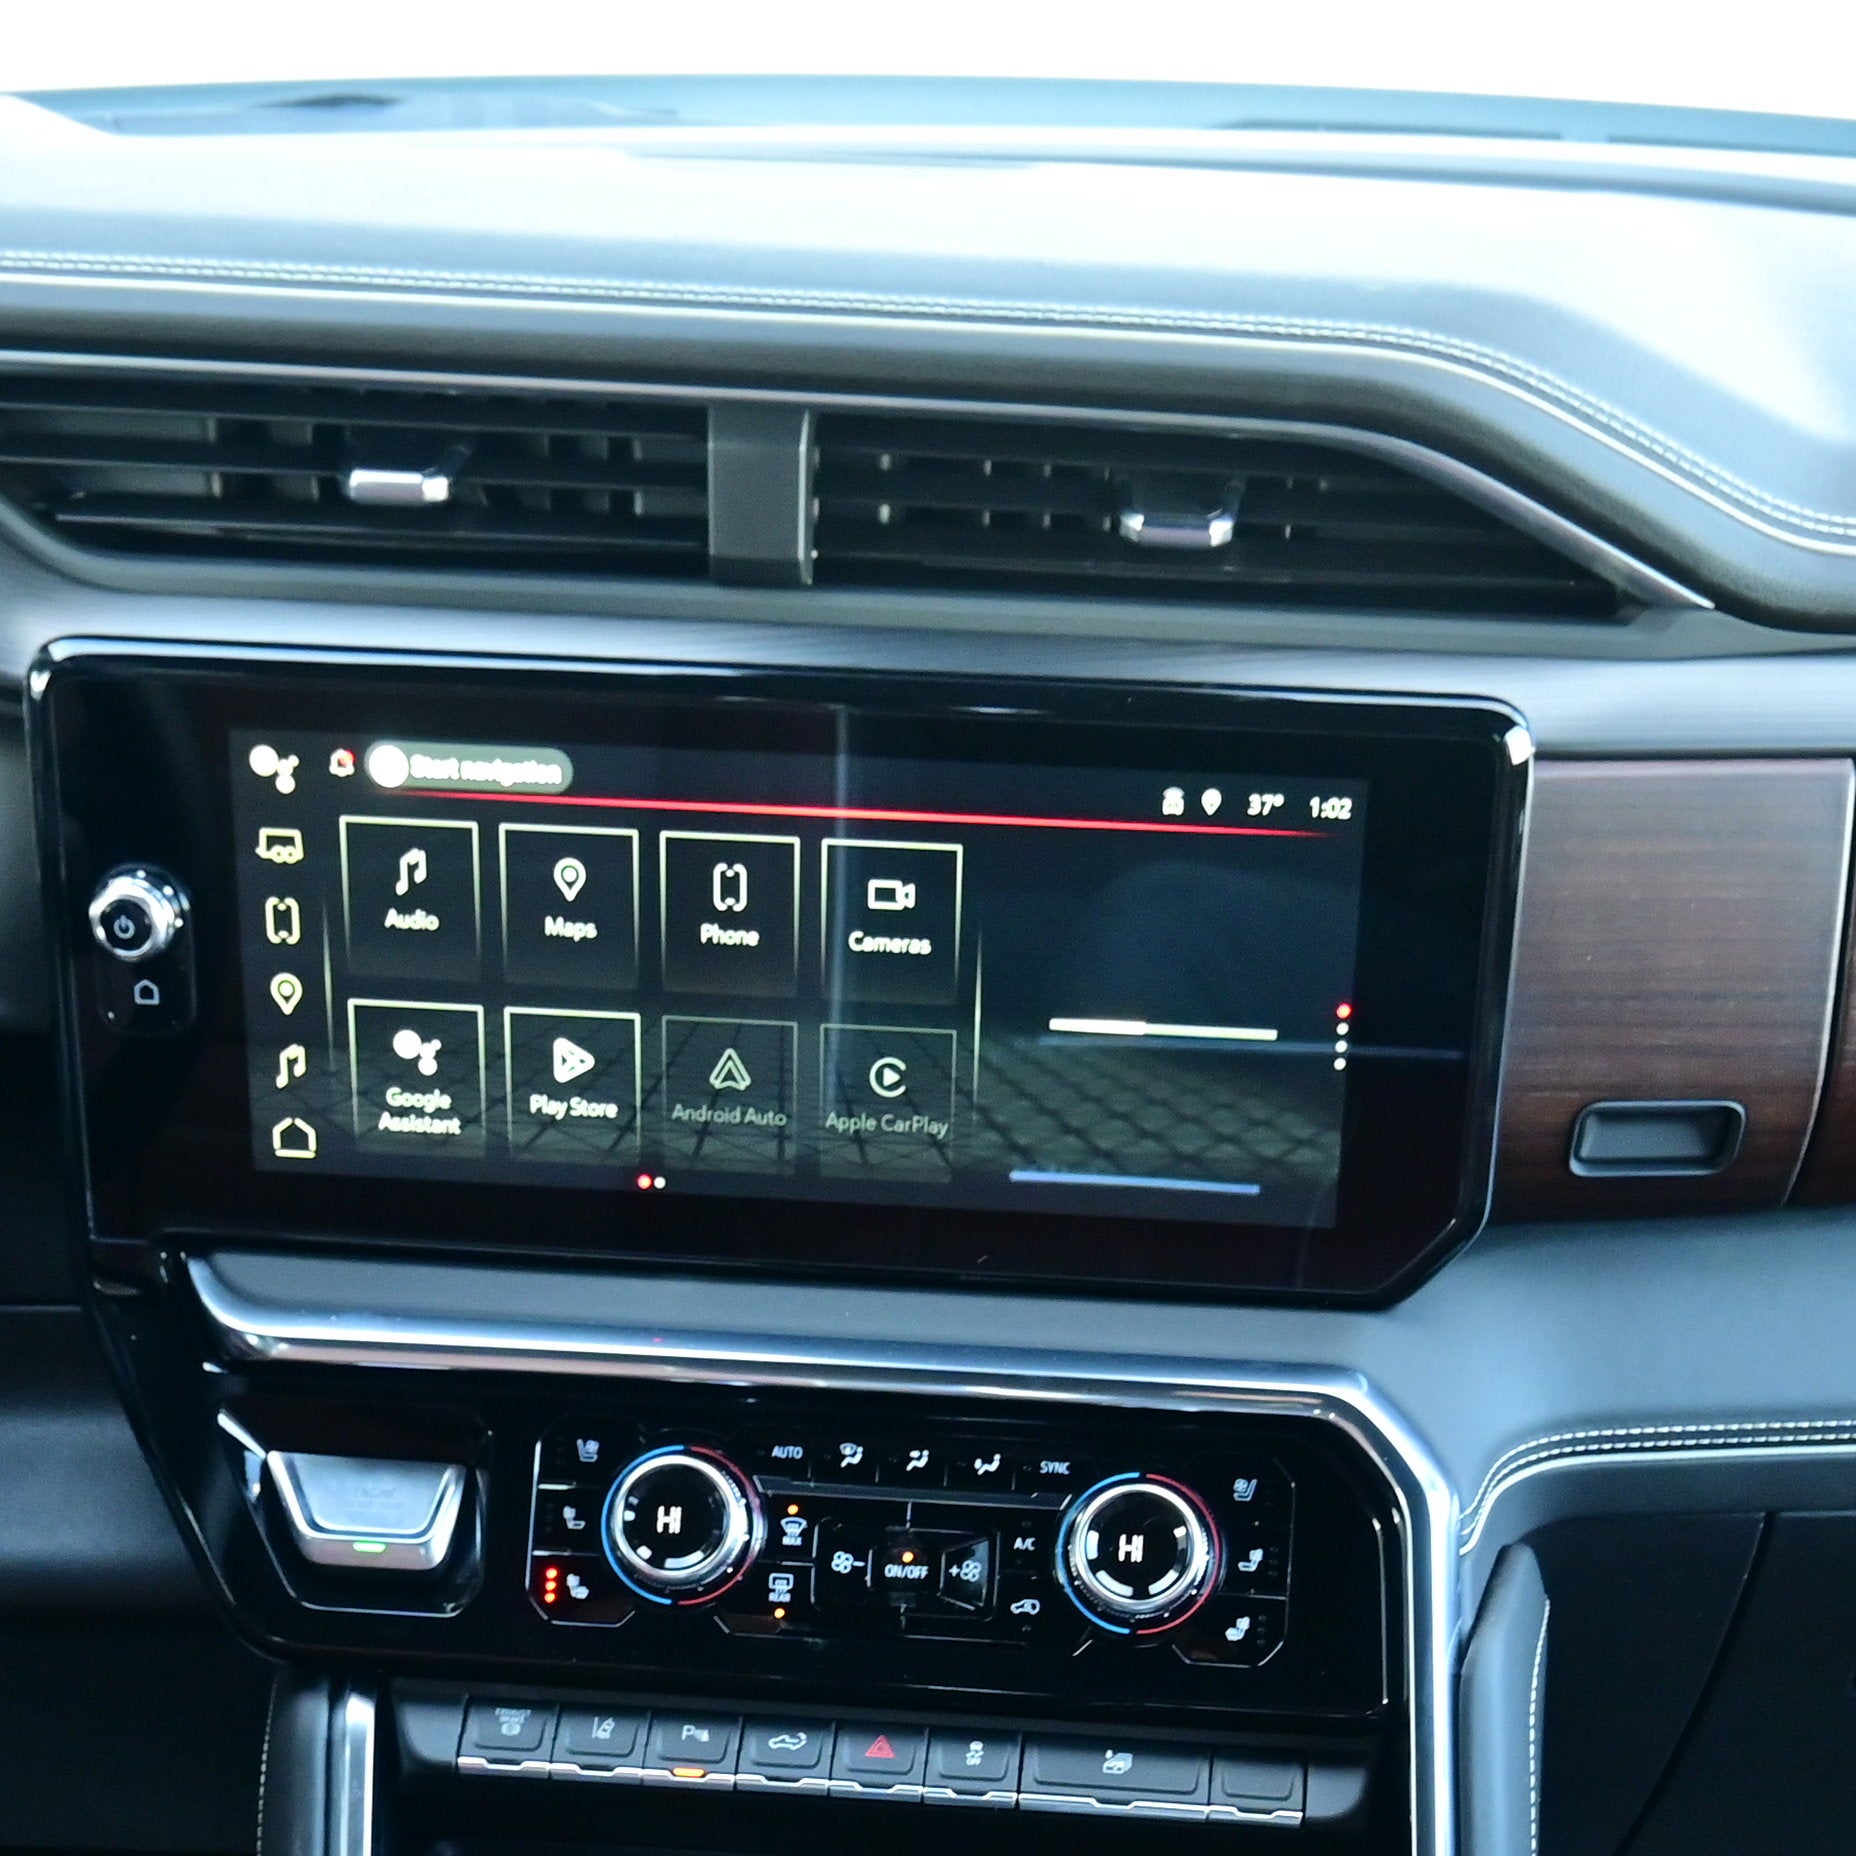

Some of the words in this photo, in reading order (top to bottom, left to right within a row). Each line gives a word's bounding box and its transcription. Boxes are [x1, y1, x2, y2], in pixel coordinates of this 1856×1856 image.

[410, 754, 460, 780] Start
[459, 758, 563, 787] navigation
[1309, 796, 1353, 820] 1:02
[384, 909, 440, 933] Audio
[544, 915, 598, 941] Maps
[699, 923, 761, 948] Phone
[848, 931, 933, 956] Cameras
[385, 1087, 452, 1113] Google
[530, 1094, 568, 1119] Play
[569, 1096, 619, 1120] Store
[378, 1110, 462, 1137] Assistant
[671, 1103, 741, 1127] Android
[742, 1107, 787, 1128] Auto
[825, 1111, 870, 1136] Apple
[871, 1112, 950, 1138] CarPlay
[770, 1445, 804, 1460] AUTO
[1039, 1459, 1070, 1476] SYNC
[655, 1504, 683, 1536] HI
[1013, 1536, 1037, 1552] A/C
[1117, 1533, 1144, 1563] HI
[884, 1564, 929, 1581] ON/OFF
